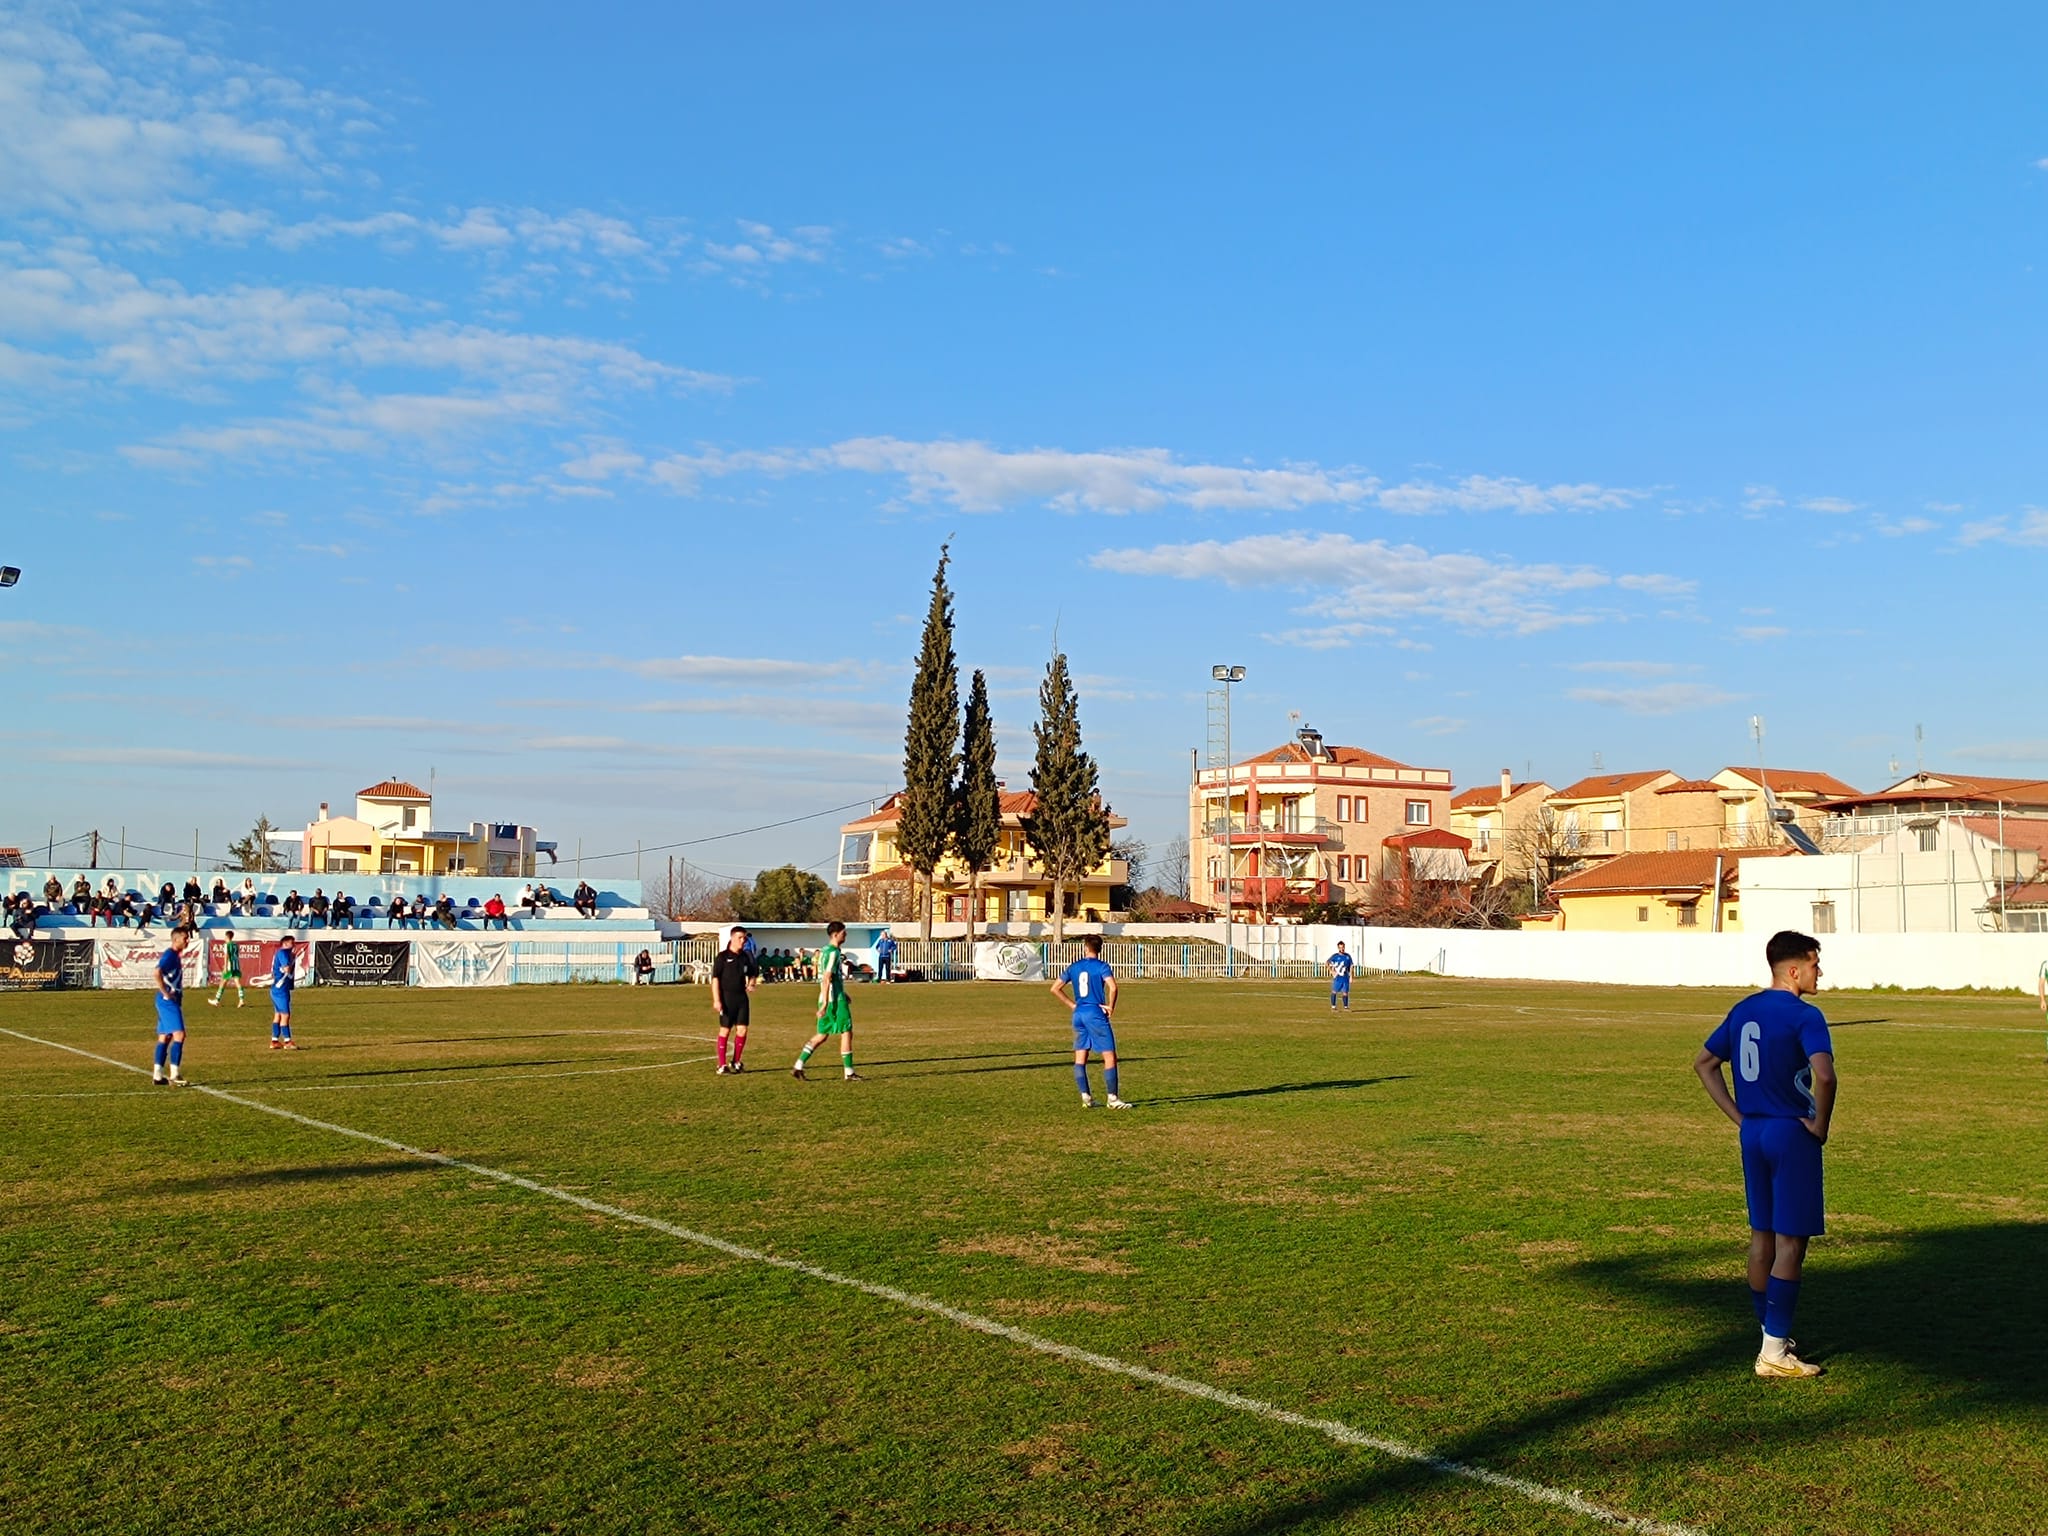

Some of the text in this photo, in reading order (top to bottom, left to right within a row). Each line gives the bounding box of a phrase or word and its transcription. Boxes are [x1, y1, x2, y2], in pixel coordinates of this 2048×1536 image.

[333, 954, 393, 966] SIROCCO
[1078, 971, 1089, 998] 8
[1739, 1021, 1761, 1082] 6
